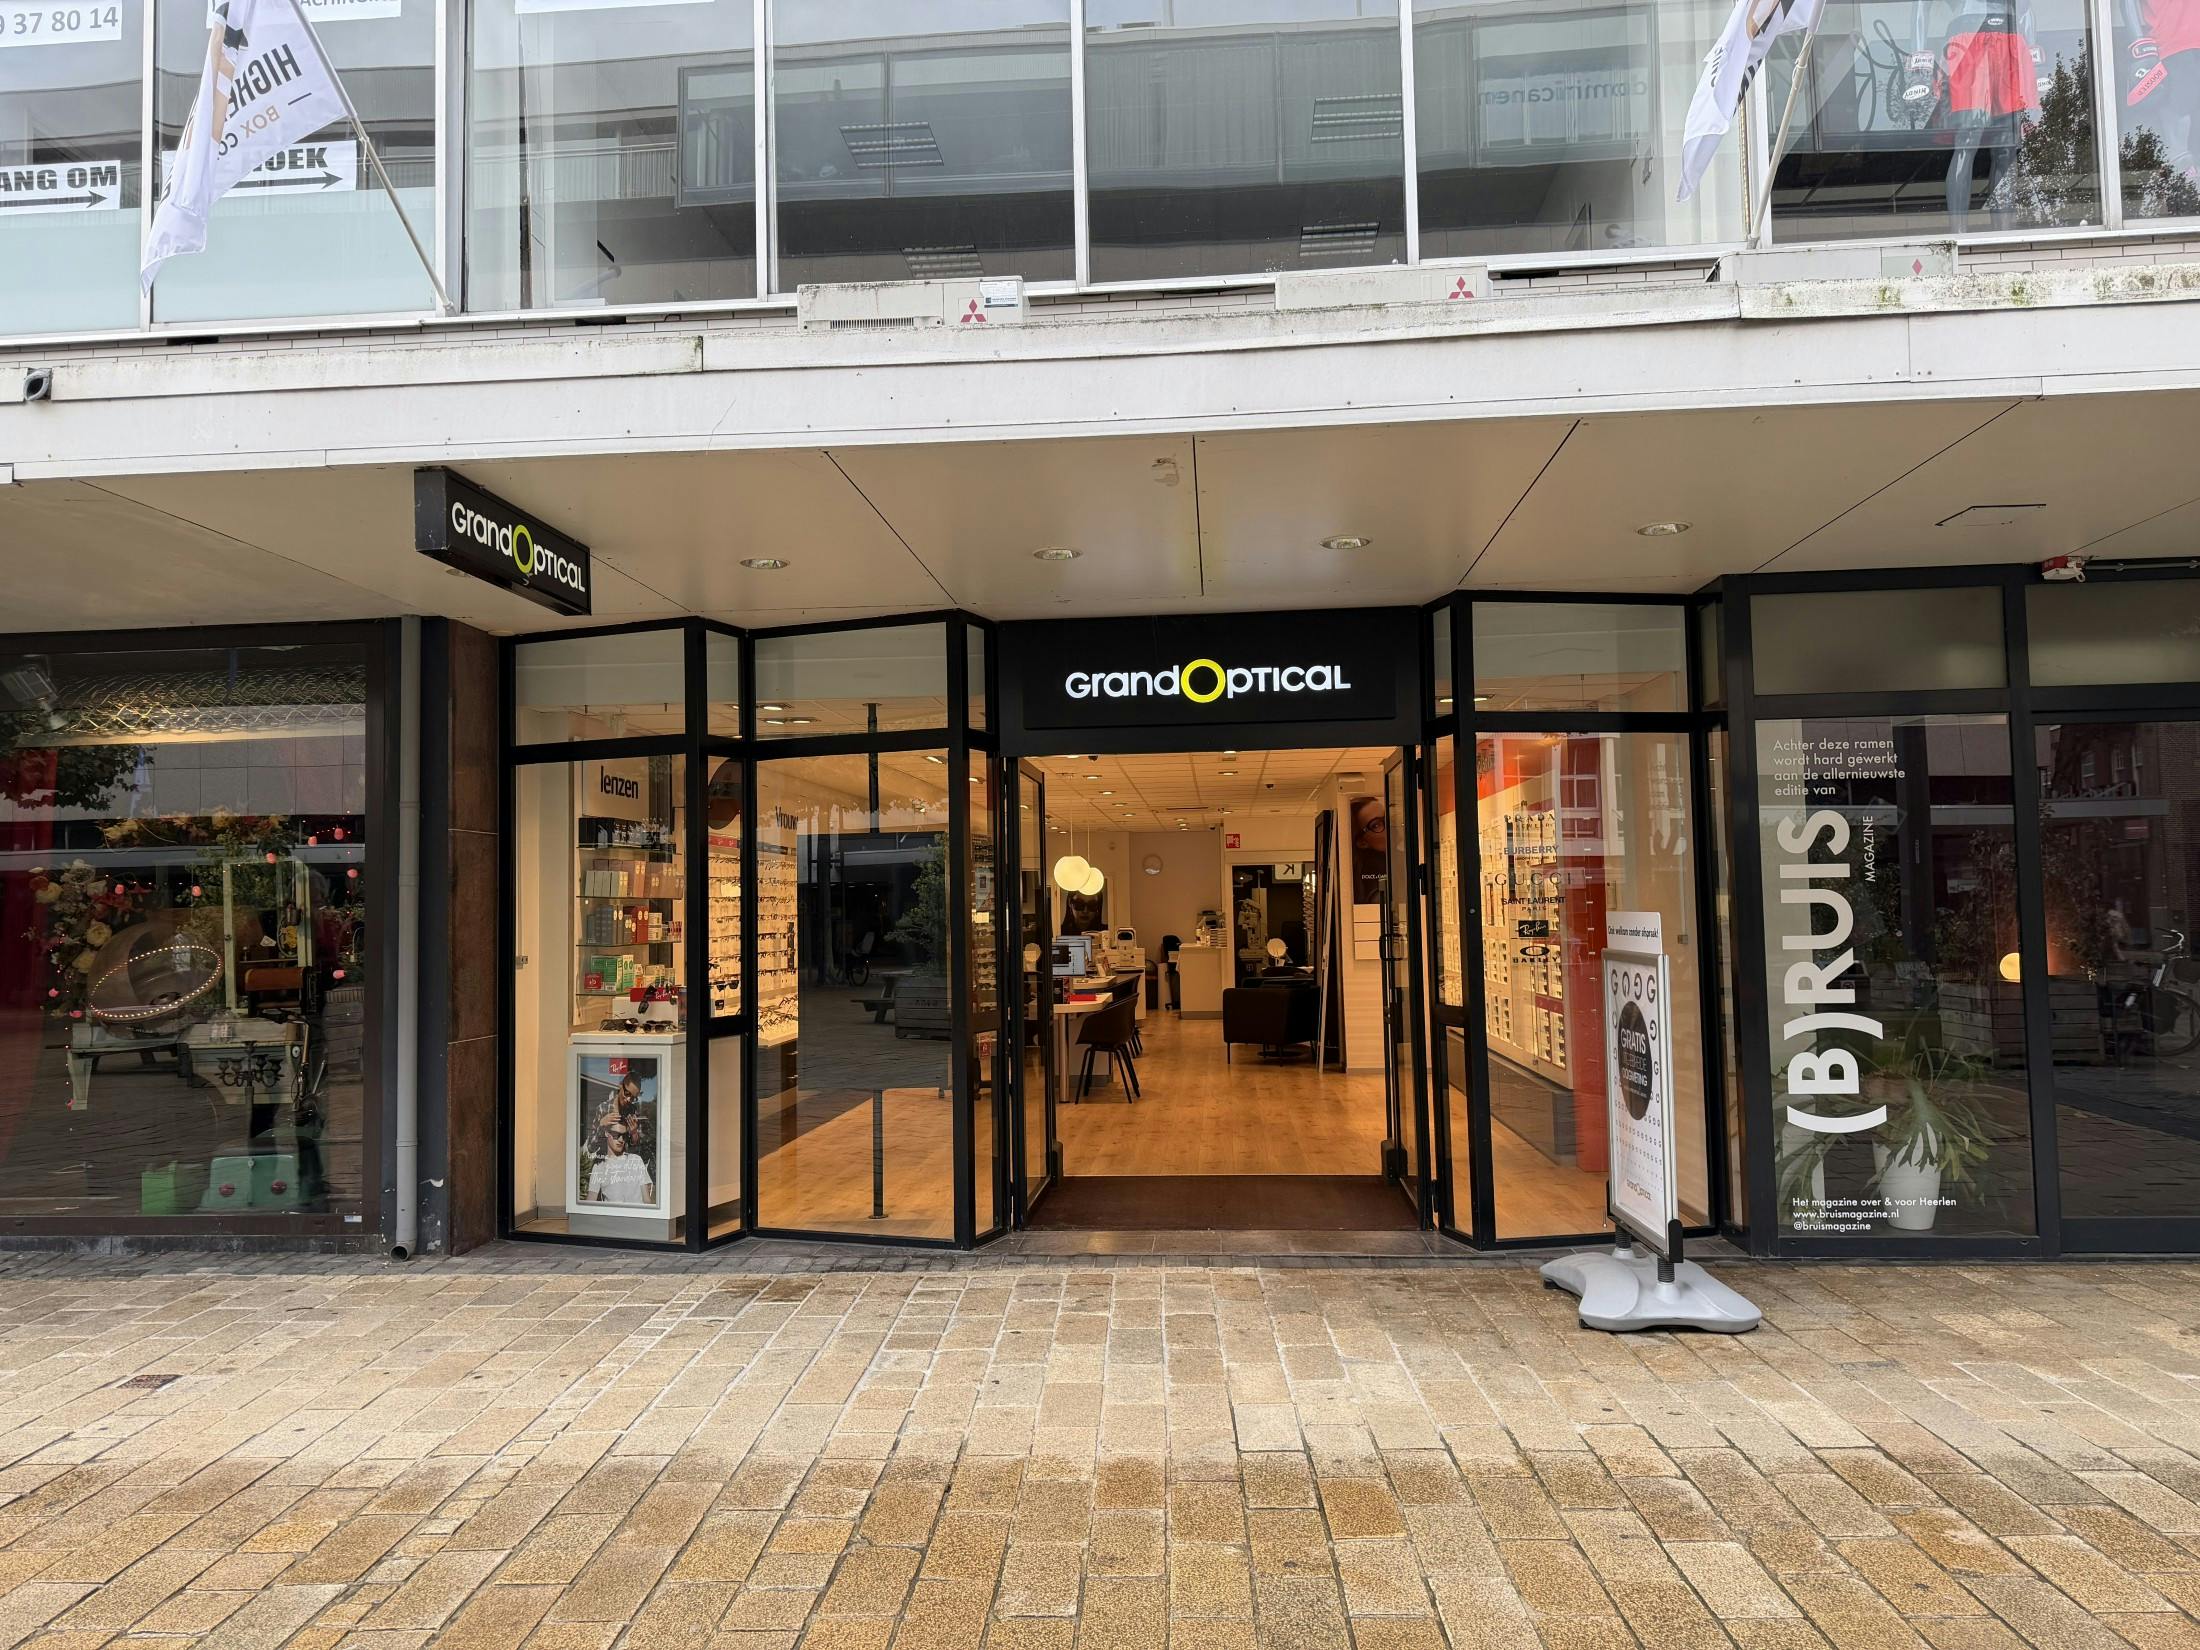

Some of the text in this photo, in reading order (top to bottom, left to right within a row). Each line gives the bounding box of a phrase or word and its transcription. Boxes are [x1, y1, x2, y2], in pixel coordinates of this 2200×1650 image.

[14, 12, 43, 35] 37
[51, 9, 81, 32] 80
[89, 6, 119, 29] 14
[252, 147, 329, 172] OEK
[67, 165, 118, 189] OM
[1065, 658, 1352, 703] GrandOptical
[1773, 738, 1894, 751] Achter deze ramen
[1774, 753, 1898, 767] wordt hard gewerkt
[1774, 767, 1906, 781] aan de allernieuwste
[600, 766, 639, 799] lenzen
[1775, 784, 1836, 796] editie van
[1504, 813, 1556, 823] PRADA
[1504, 846, 1560, 855] BURBERRY
[1862, 815, 1877, 882] MAGAZINE
[1495, 872, 1572, 885] GUCCI
[1501, 897, 1566, 906] SAINT LAURENT
[1776, 809, 1888, 1134] (B)RUIS
[1620, 1028, 1646, 1054] GRATIS
[1793, 1198, 1808, 1207] Het
[1812, 1198, 1858, 1209] magazine
[1884, 1198, 1892, 1207] &
[1895, 1199, 1917, 1207] voor
[1920, 1197, 1957, 1207] Heerlen
[1793, 1209, 1900, 1220] www.bruismagazine.nl
[1793, 1221, 1871, 1233] @bruismagazine
